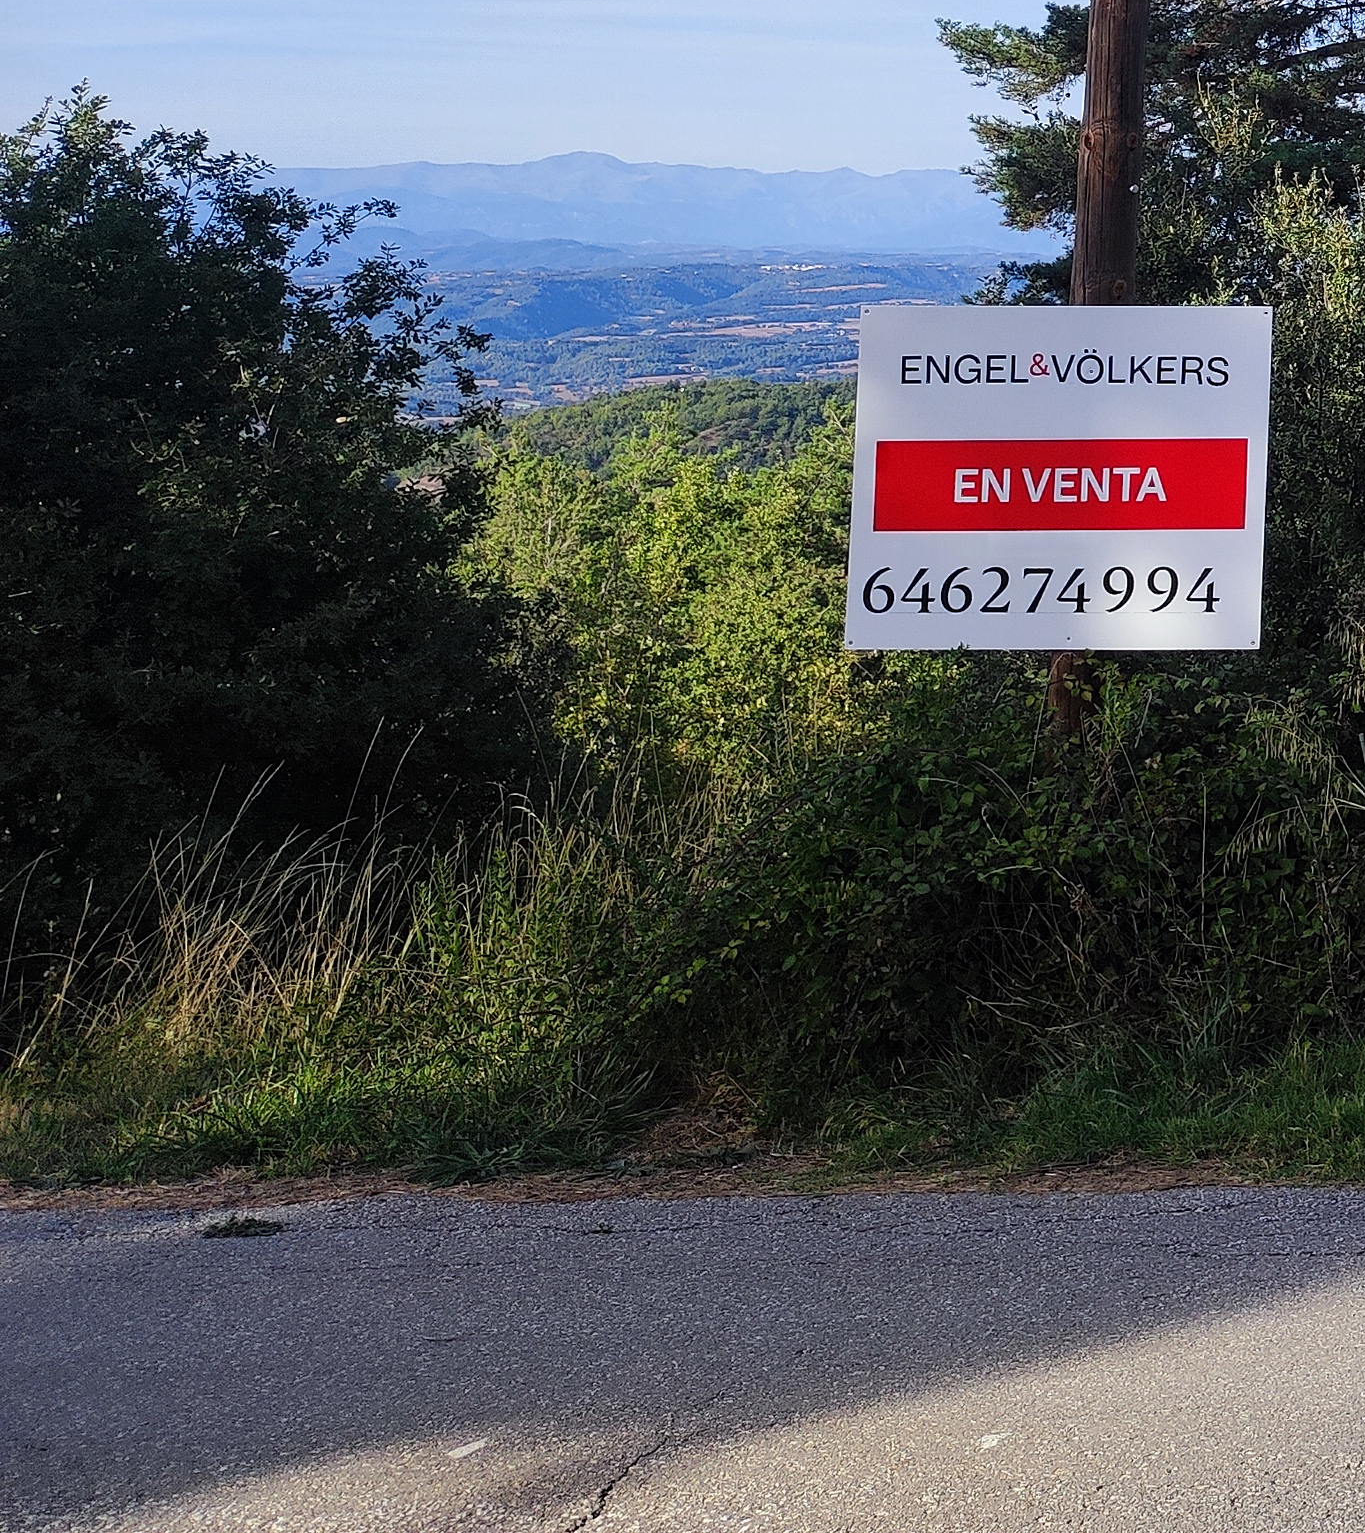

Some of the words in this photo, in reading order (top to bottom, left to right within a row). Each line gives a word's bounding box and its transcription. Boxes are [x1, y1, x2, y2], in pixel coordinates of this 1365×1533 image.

[900, 348, 1229, 387] ENGEL&VÖLKERS
[953, 468, 1011, 503] EN
[1021, 467, 1167, 503] VENTA
[862, 566, 1221, 614] 646274994
